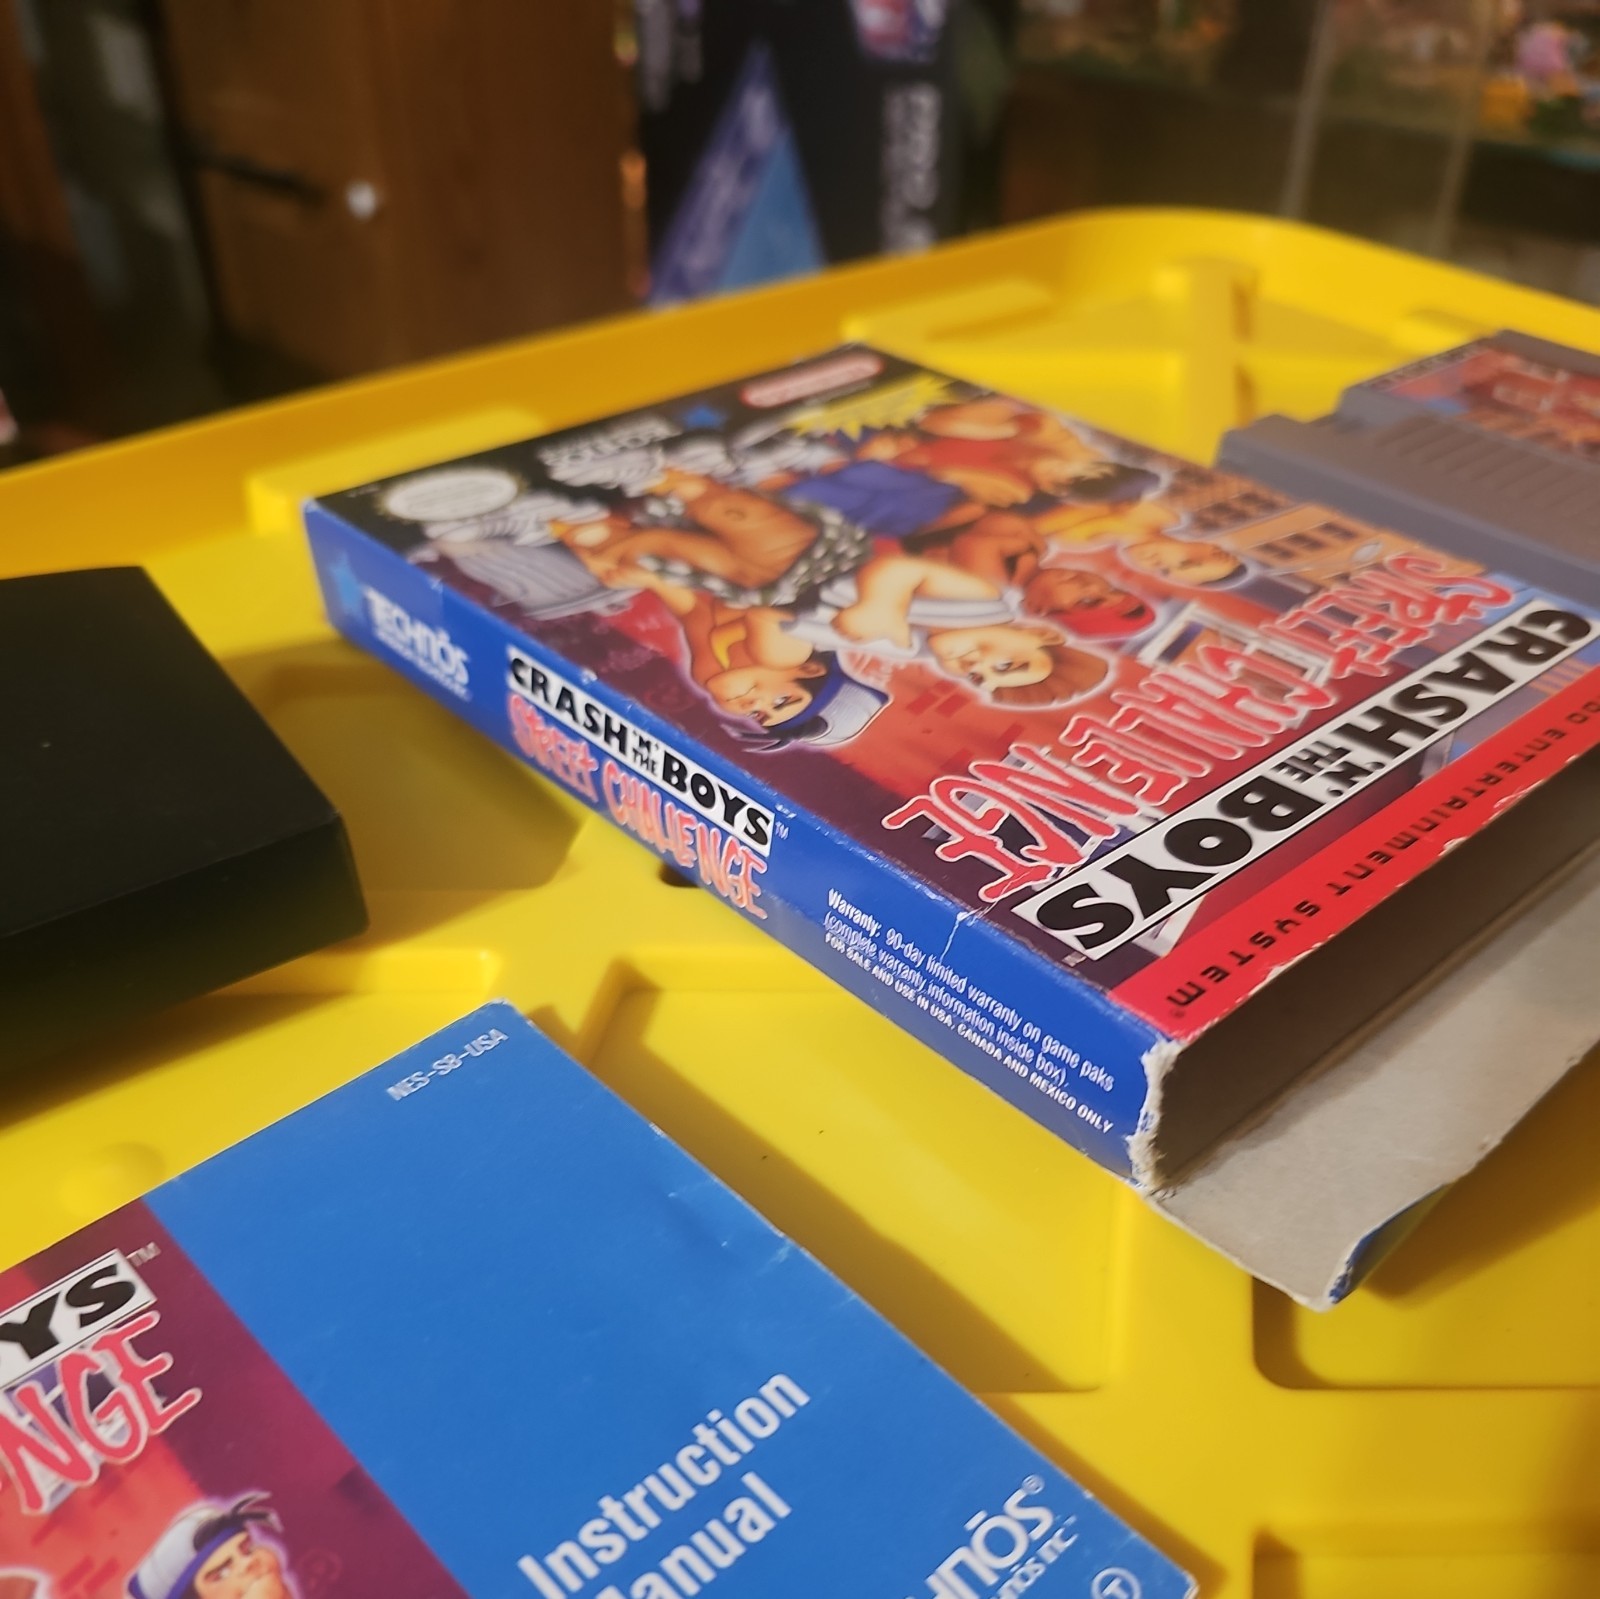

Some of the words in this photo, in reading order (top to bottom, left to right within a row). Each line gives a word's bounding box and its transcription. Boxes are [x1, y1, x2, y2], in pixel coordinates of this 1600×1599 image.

[510, 657, 627, 756] CRASH
[632, 747, 657, 776] THE
[661, 752, 771, 847] BOYS
[1270, 740, 1352, 783] THE
[1333, 608, 1592, 763] CRASH
[508, 692, 599, 804] STREET
[602, 759, 769, 921] CHALLENGE
[1036, 775, 1327, 950] BOYS
[1327, 728, 1566, 898] ENTERTAINMENT
[823, 910, 878, 959] (complete
[878, 948, 927, 993] warranty
[927, 979, 996, 1038] information
[996, 1025, 1036, 1065] inside
[825, 931, 846, 955] FOR
[846, 945, 872, 973] SALE
[871, 964, 895, 988] AND
[894, 981, 917, 1002] USE
[916, 994, 931, 1012] IN
[930, 1003, 956, 1030] USA,
[957, 1022, 1004, 1062] CANADA
[1002, 1053, 1030, 1079] AND
[1029, 1071, 1078, 1112] MEXICO
[1077, 1103, 1115, 1135] ONLY
[886, 927, 927, 968] 90-day
[926, 953, 969, 994] limited
[968, 984, 1023, 1032] warranty
[1022, 1021, 1043, 1044] on
[1041, 1034, 1081, 1069] game
[1079, 1059, 1116, 1093] paks
[0, 1262, 138, 1362] YS
[516, 1372, 812, 1599] Instruction
[594, 1470, 793, 1599] anual
